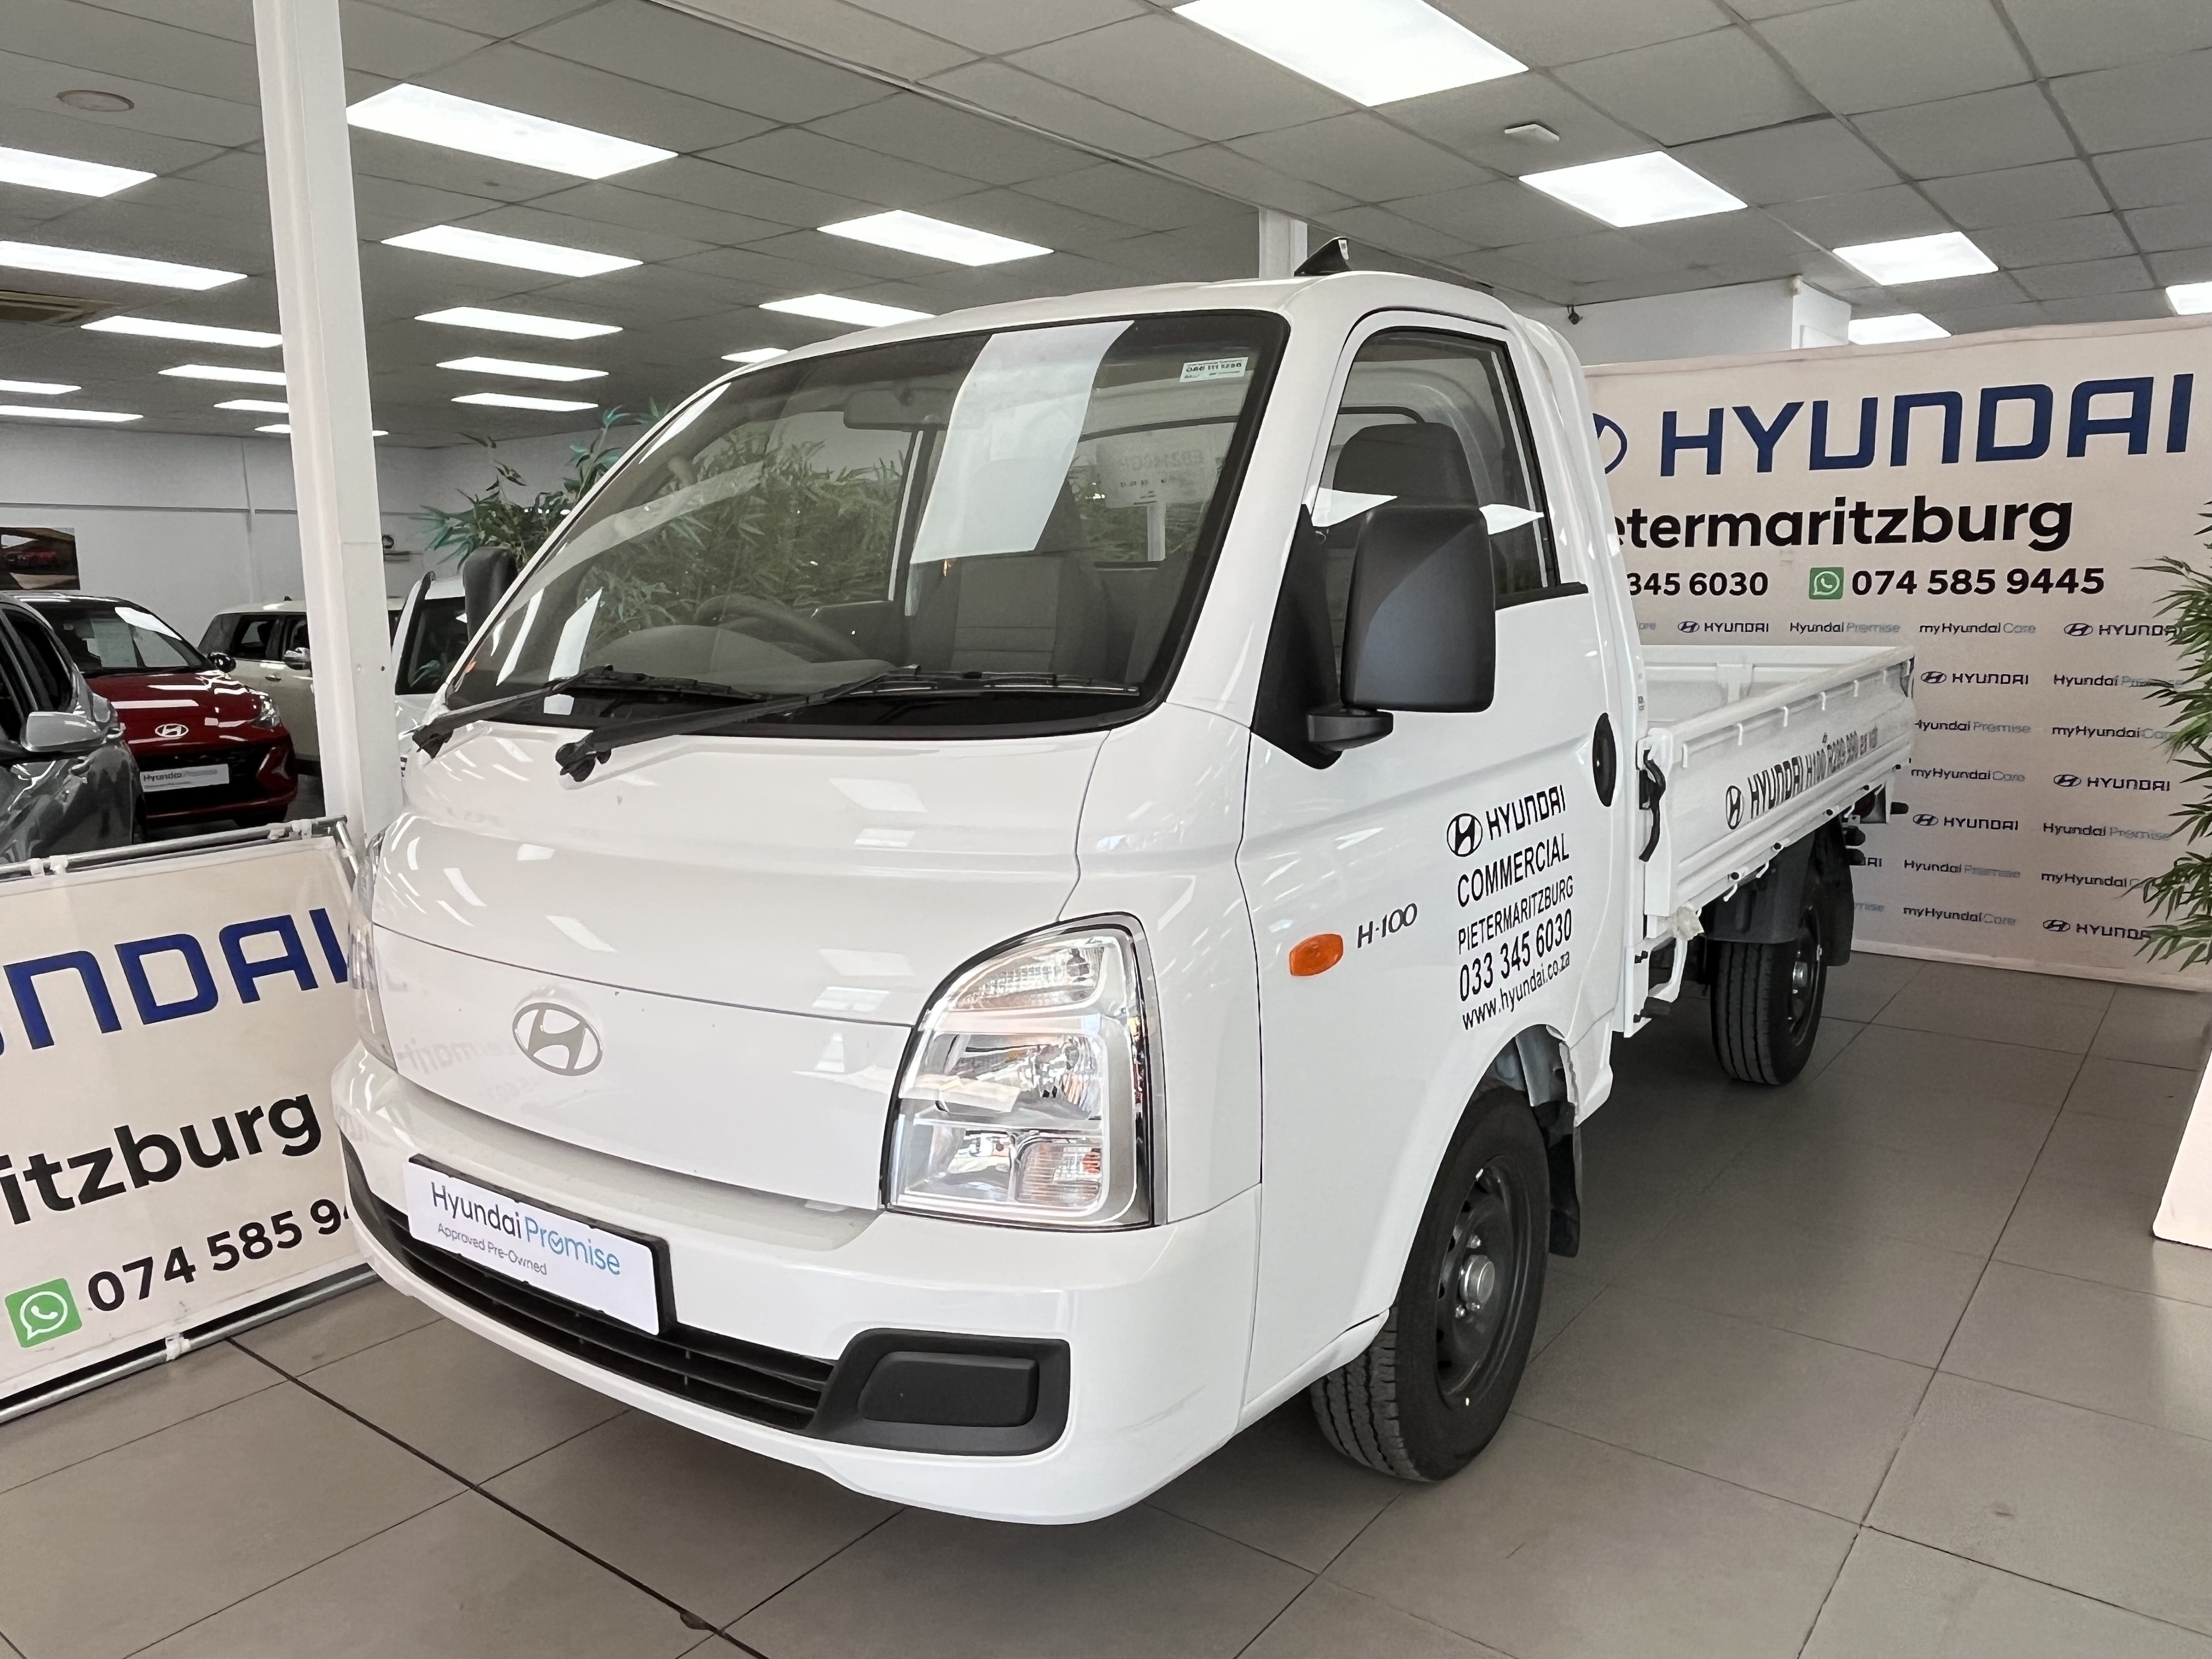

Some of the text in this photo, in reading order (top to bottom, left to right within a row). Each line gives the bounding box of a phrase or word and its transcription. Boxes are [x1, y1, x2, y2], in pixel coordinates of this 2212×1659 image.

[1661, 374, 2194, 476] HYUNDAI
[1627, 567, 2104, 596] 345 6030 074 585 9445
[1704, 623, 1769, 632] HYUNDAI
[2099, 624, 2178, 636] HYUNDA
[1953, 673, 2028, 685] HYUNDAI
[1486, 785, 1566, 840] HYUNDAI
[1748, 755, 1803, 819] HYUNDAI
[2087, 777, 2170, 791] HYUNDAI
[1944, 816, 2018, 831] HYUNDAI
[1458, 833, 1569, 907] COMMERCIAL
[1459, 876, 1573, 955] PIETERMARITZBURG
[2076, 923, 2151, 940] HYUNDA
[0, 908, 349, 1056] NDAI
[1460, 909, 1572, 1001] 033 345 6030
[1463, 951, 1570, 1030] www.hyundai.co.za
[0, 1094, 322, 1224] itzburg
[88, 1199, 349, 1311] 074 585 9
[438, 1223, 547, 1276] Approved Pre-Owned
